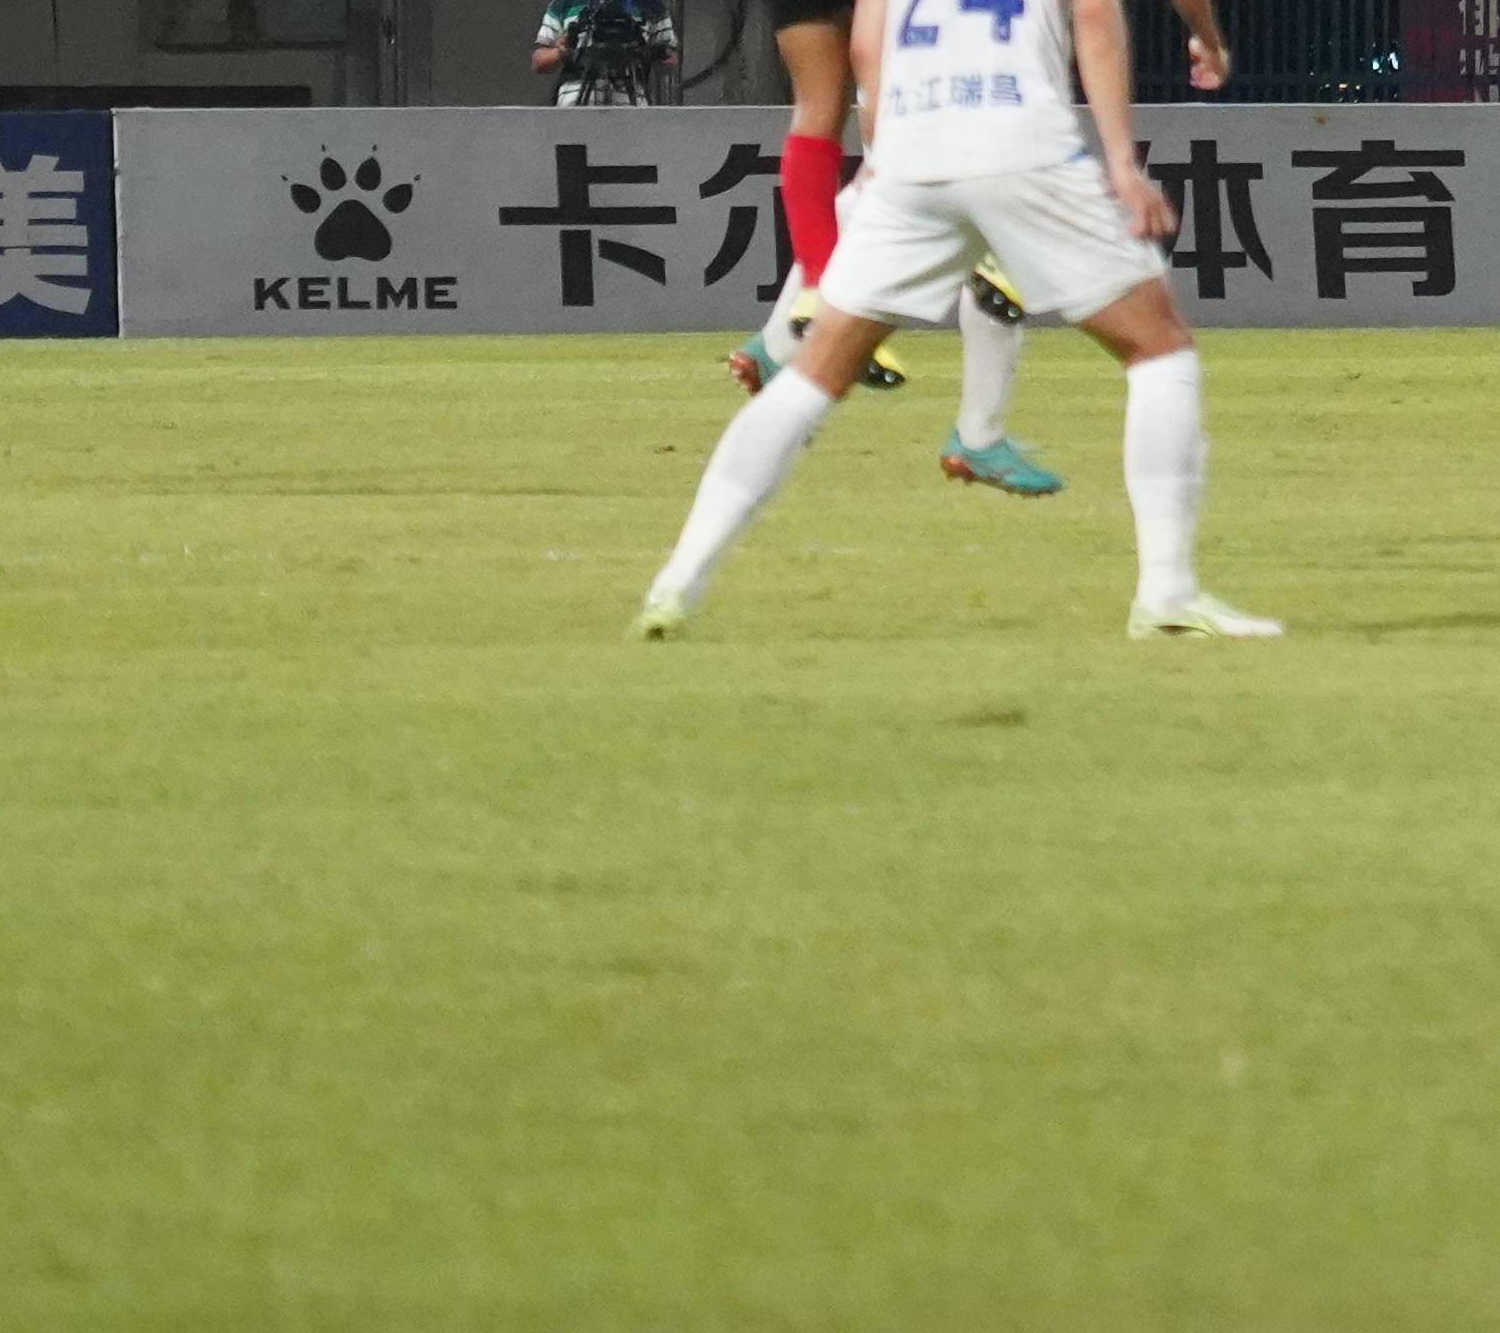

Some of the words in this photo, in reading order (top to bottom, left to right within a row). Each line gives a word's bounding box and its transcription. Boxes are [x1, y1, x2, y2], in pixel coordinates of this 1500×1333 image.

[499, 139, 1466, 307] 卡尔体育
[254, 276, 458, 311] KELME
